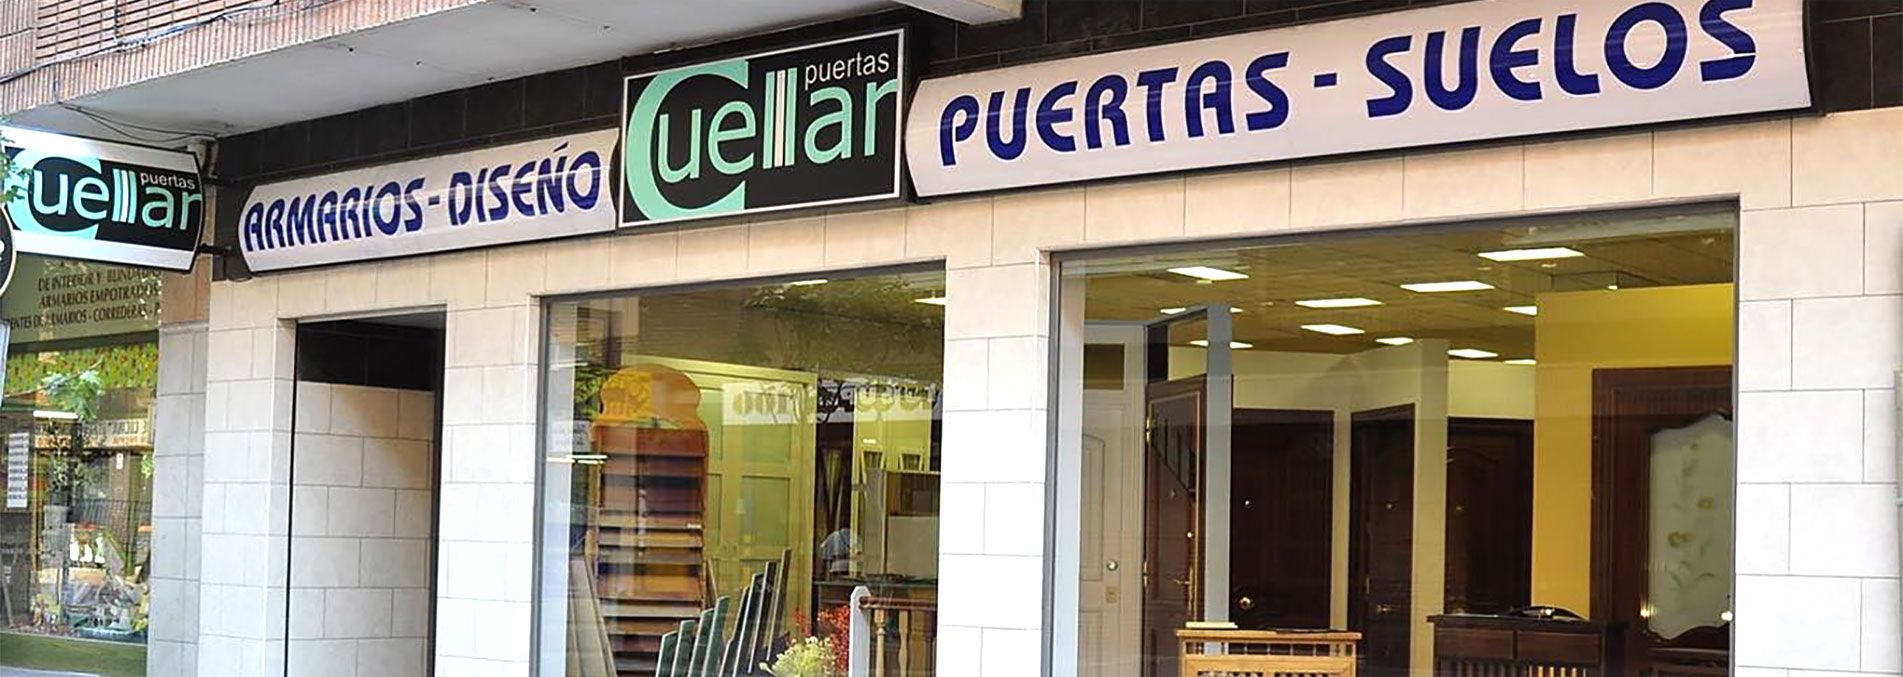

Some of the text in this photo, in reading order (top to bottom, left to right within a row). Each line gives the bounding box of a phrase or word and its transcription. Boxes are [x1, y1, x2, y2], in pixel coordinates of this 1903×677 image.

[805, 52, 890, 90] puertas
[939, 51, 1290, 166] PUERTAS
[1366, 0, 1756, 118] SUELOS
[140, 171, 196, 190] puertas
[244, 176, 426, 252] ARMARIOS
[448, 141, 602, 226] DISEÑO
[38, 276, 49, 291] DE
[40, 289, 88, 309] ARMARIOS
